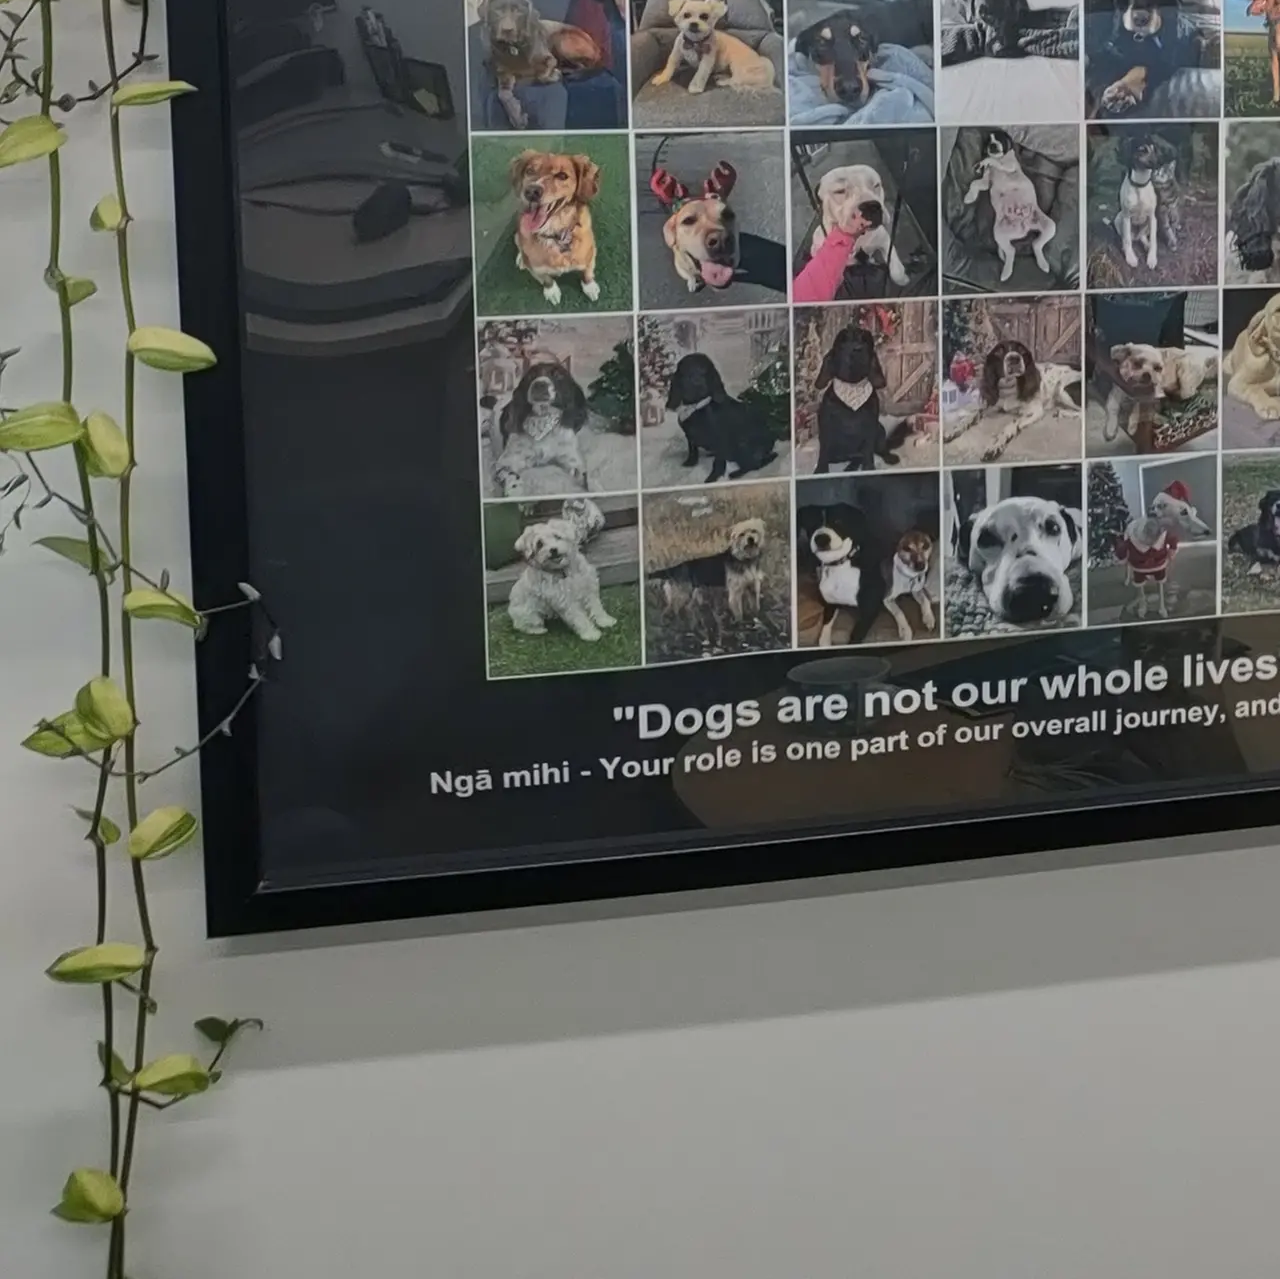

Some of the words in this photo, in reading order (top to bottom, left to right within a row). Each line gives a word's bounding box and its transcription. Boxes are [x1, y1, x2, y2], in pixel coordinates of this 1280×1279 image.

[612, 699, 762, 741] "Dogs
[776, 693, 849, 724] are
[864, 679, 939, 718] not
[951, 676, 1029, 709] our
[1039, 659, 1169, 701] whole
[1183, 652, 1278, 689] lives
[429, 768, 493, 798] Ngā
[502, 760, 570, 789] mihi
[598, 756, 676, 780] Your
[683, 744, 742, 773] role
[751, 739, 777, 764] is
[785, 740, 842, 761] one
[850, 729, 910, 762] part
[916, 723, 948, 748] of
[954, 722, 1005, 744] our
[1011, 709, 1107, 739] overall
[1113, 703, 1226, 735] journey,
